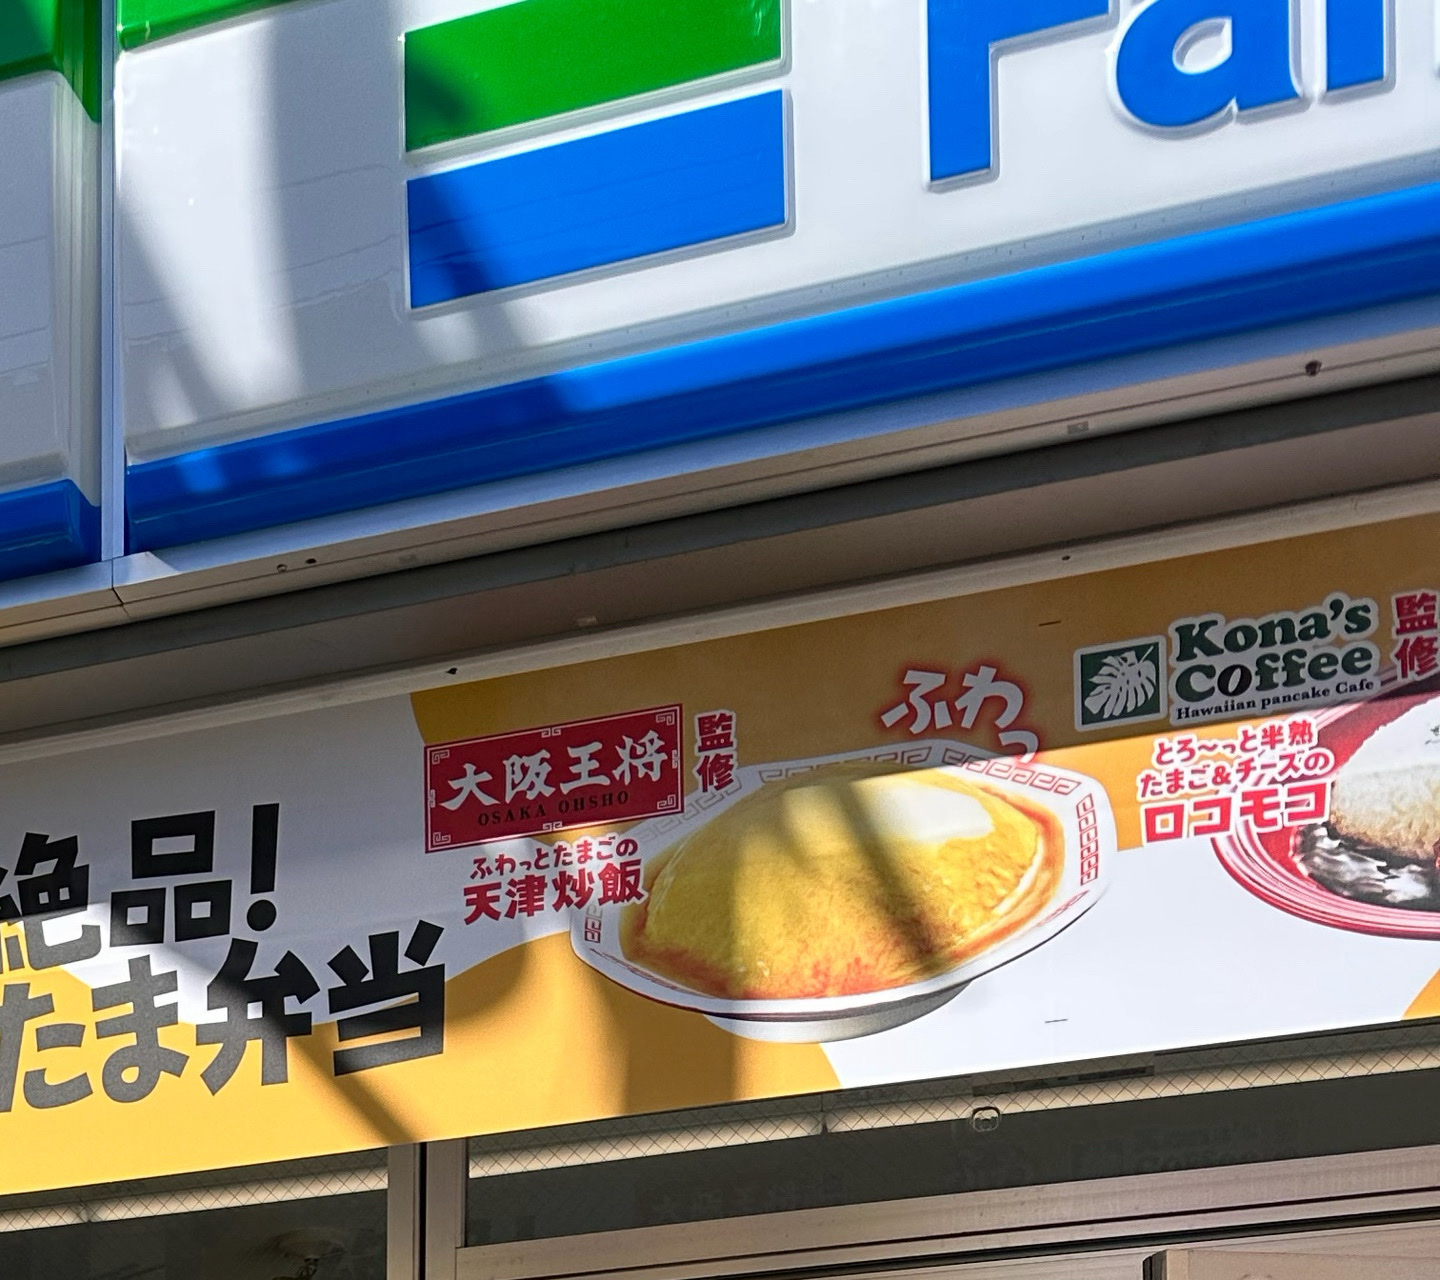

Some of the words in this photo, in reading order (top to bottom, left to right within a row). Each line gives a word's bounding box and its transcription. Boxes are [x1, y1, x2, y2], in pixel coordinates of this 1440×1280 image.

[1173, 599, 1374, 663] Kona's
[1394, 592, 1440, 681] 監修
[1174, 642, 1374, 704] Coffee
[1175, 699, 1258, 721] Hawaiian
[1260, 687, 1331, 712] pancake
[1334, 678, 1375, 697] Cafe
[438, 729, 669, 812] 大阪王将
[696, 712, 736, 793] 監修
[477, 802, 547, 827] OSAKA
[557, 790, 630, 816] OHSHO
[1144, 780, 1329, 845] ロコモコ
[470, 836, 639, 880] ふわっとたまごの
[462, 858, 647, 926] 天津炒飯
